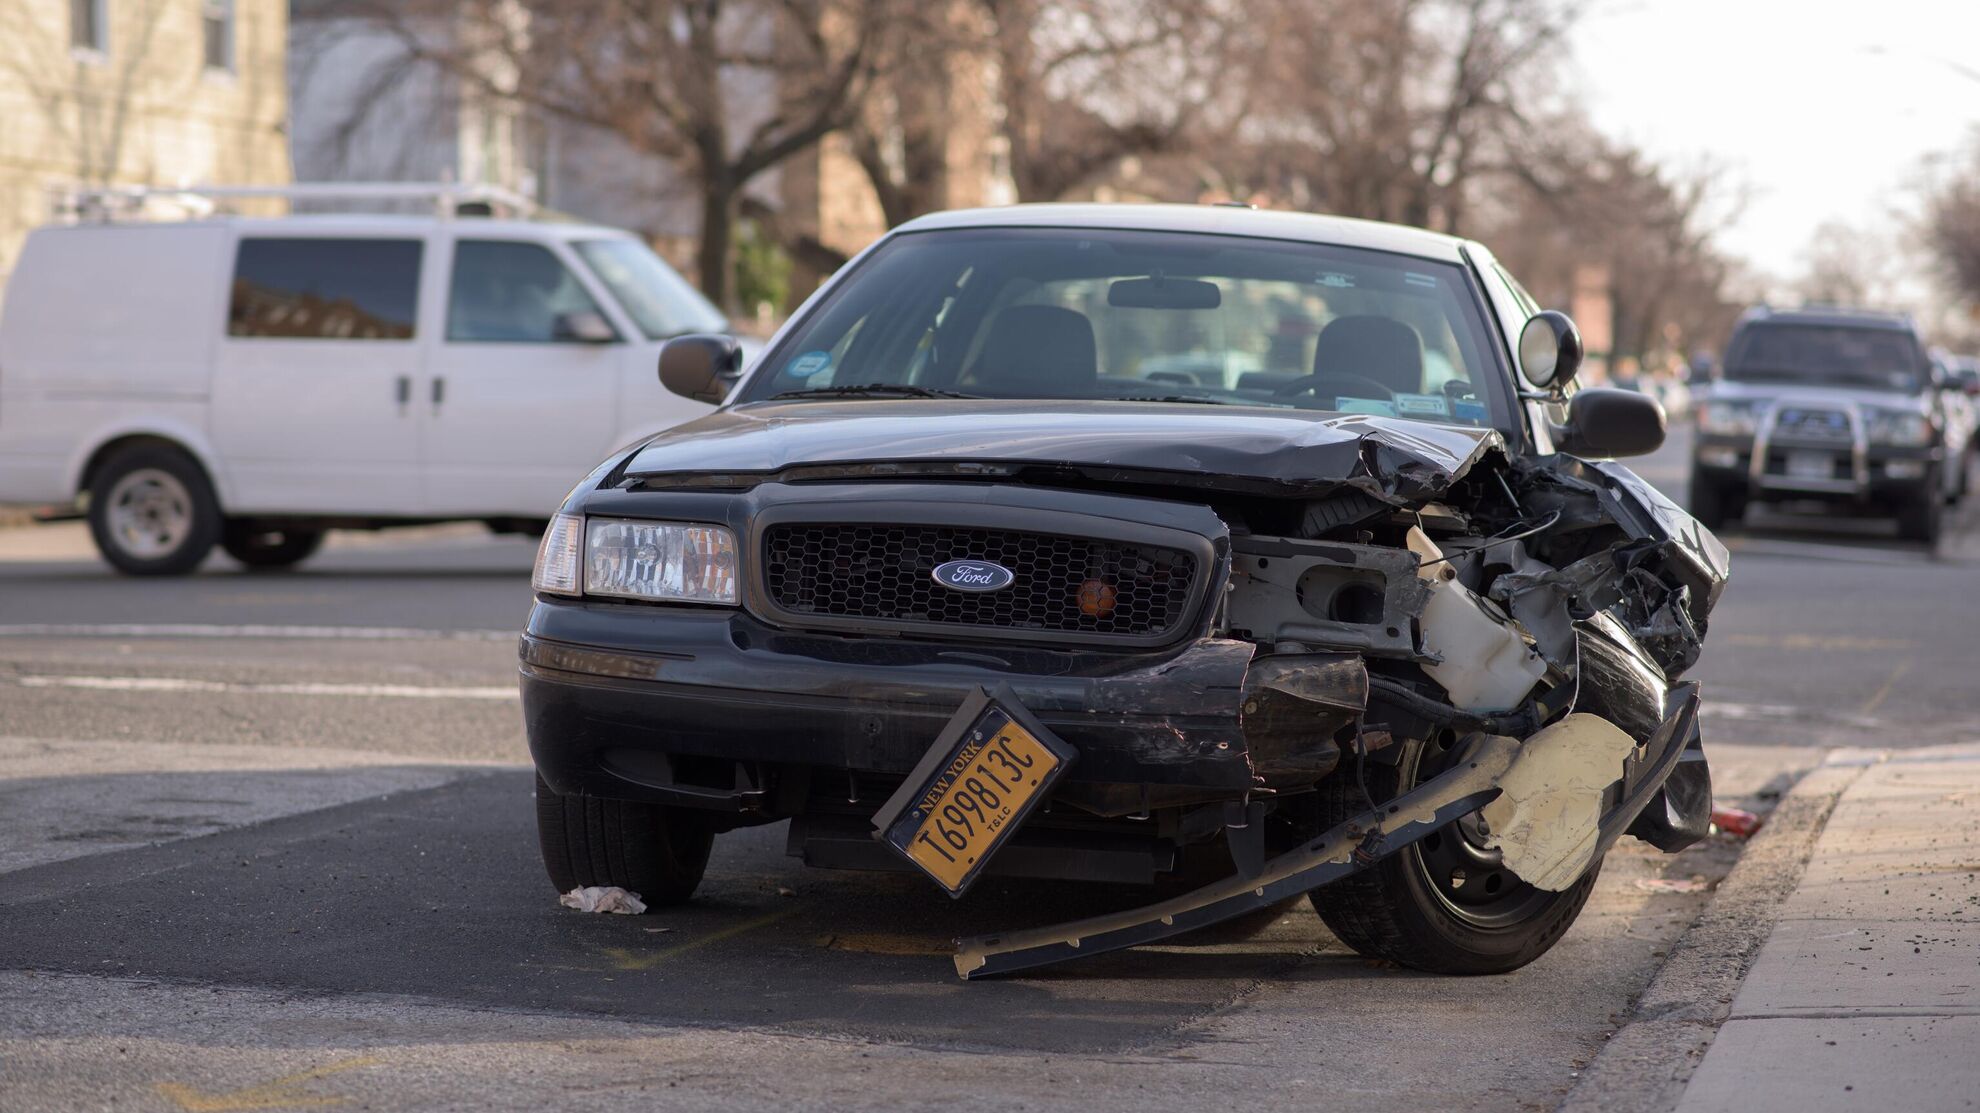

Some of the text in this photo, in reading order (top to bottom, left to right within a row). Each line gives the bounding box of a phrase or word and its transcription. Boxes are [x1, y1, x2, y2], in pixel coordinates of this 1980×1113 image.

[952, 565, 994, 584] Ford
[918, 739, 983, 815] NEW YORK
[918, 736, 1033, 863] T699813C
[987, 806, 1011, 833] T&LC
